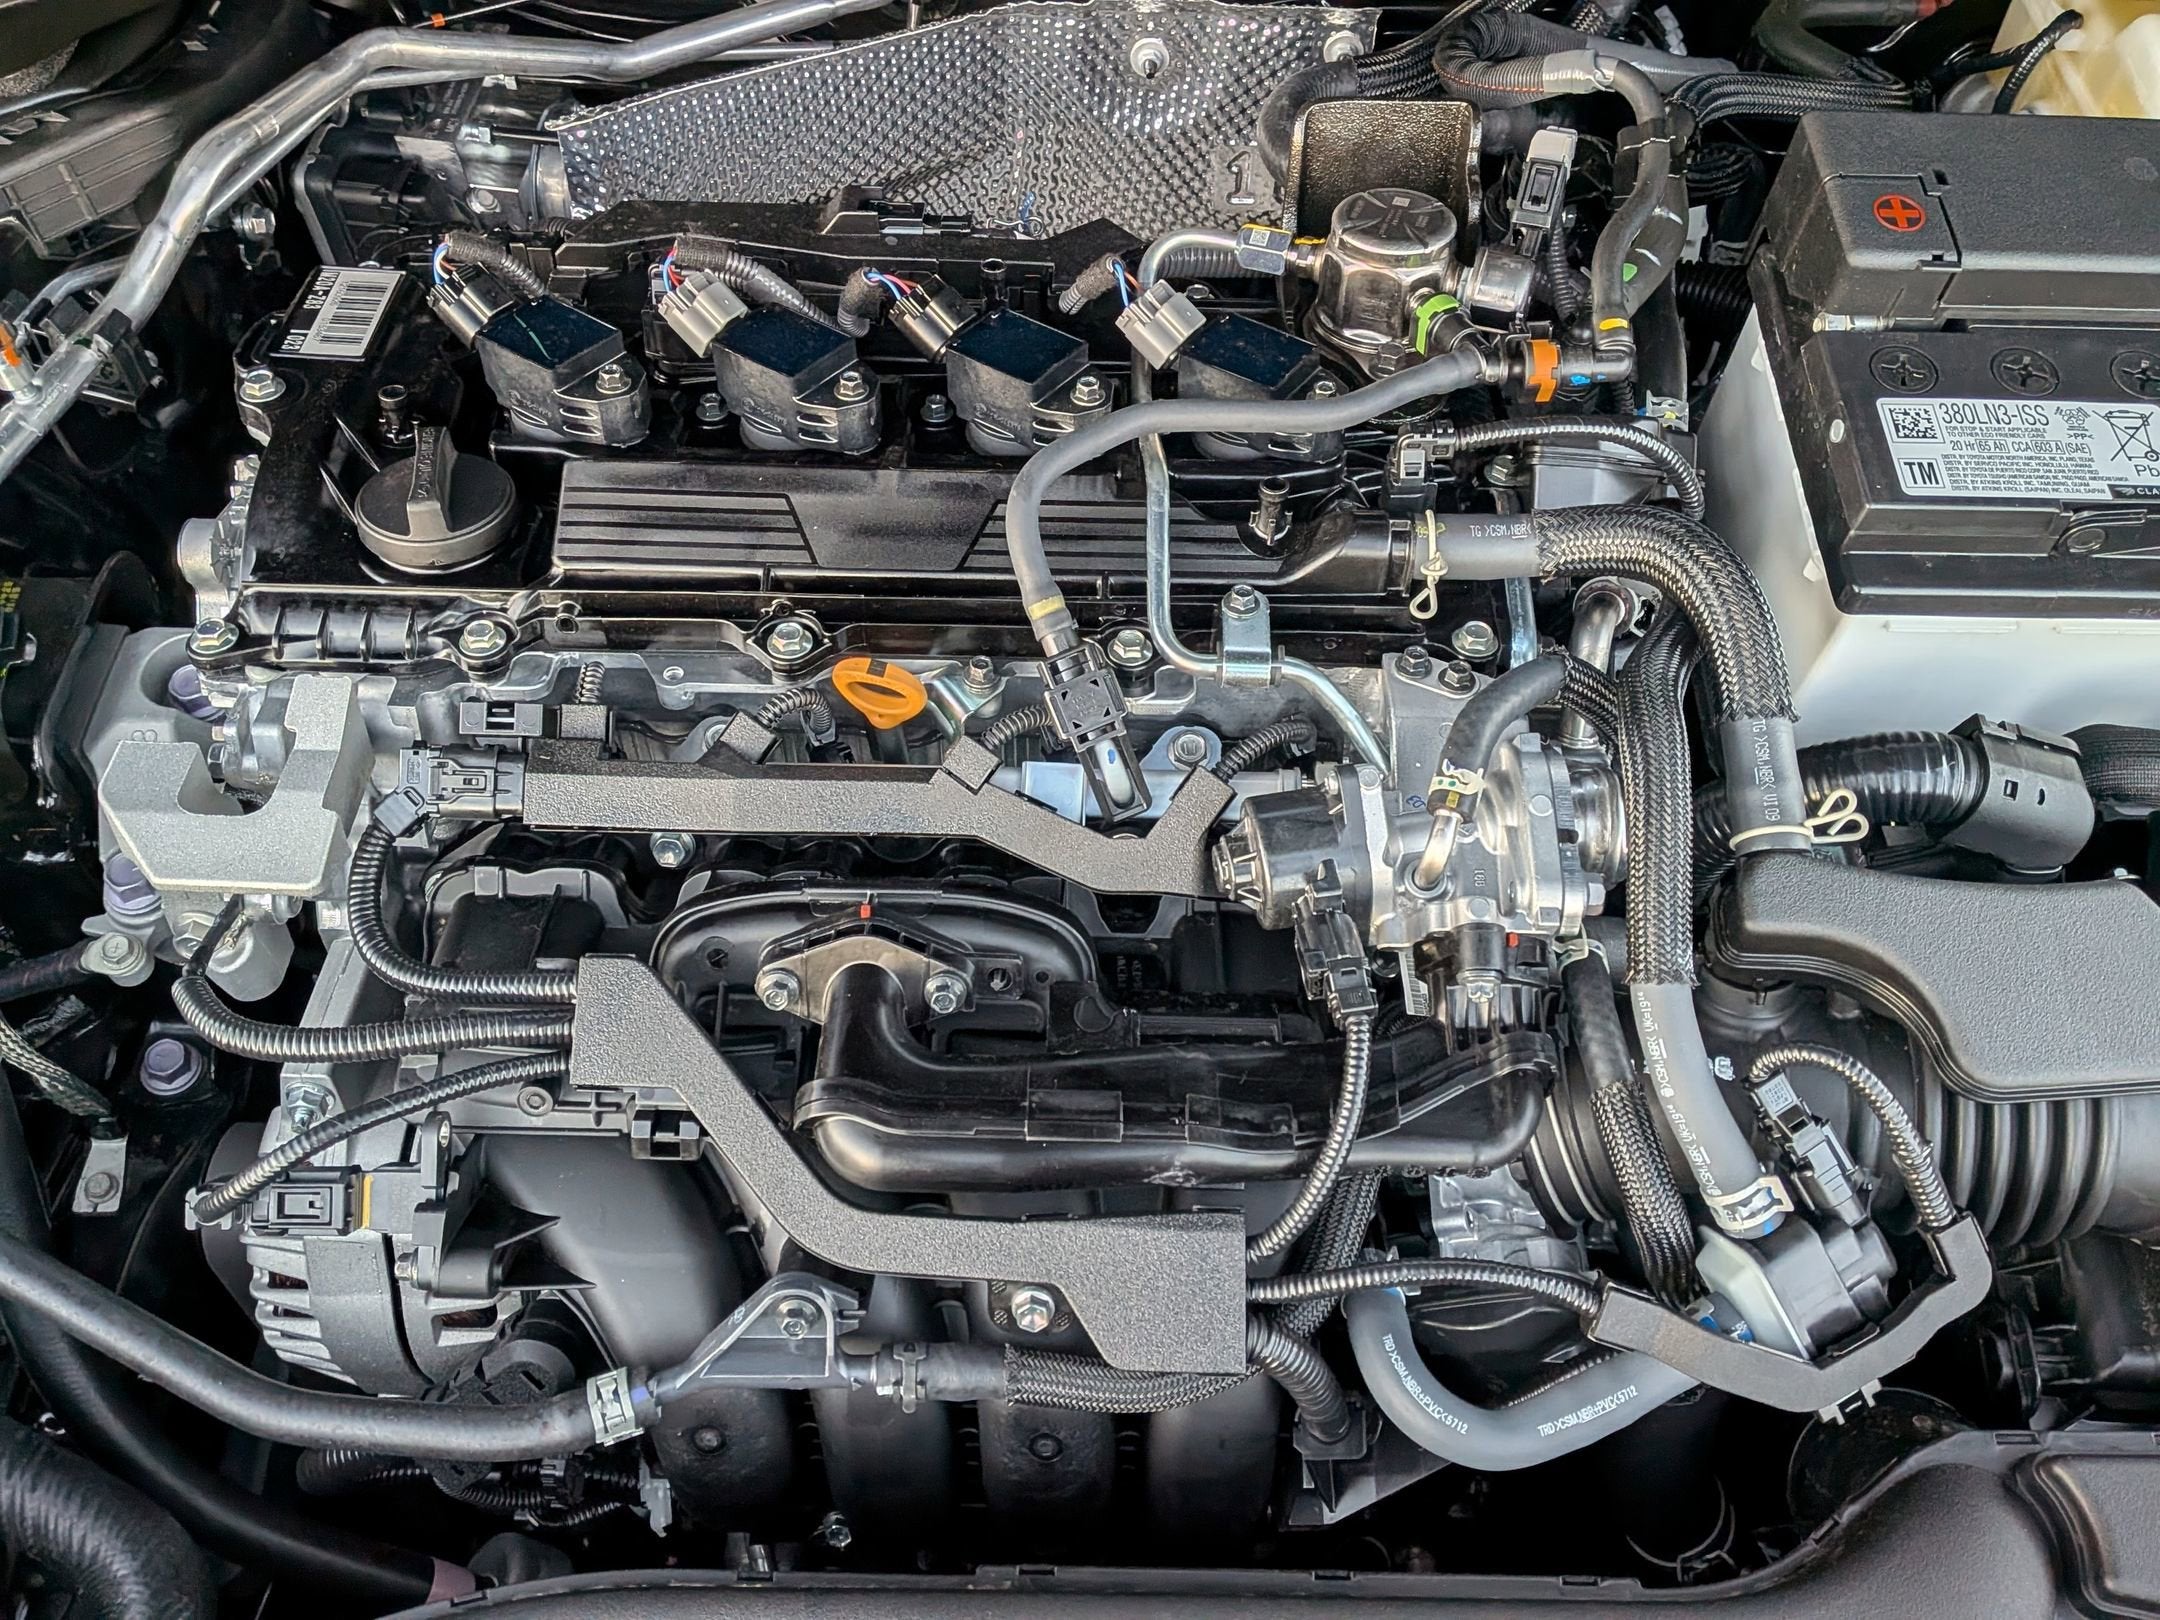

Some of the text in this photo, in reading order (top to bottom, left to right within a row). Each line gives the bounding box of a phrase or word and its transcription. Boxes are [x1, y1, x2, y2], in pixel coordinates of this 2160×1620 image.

[1227, 150, 1256, 205] 1
[1939, 403, 2049, 426] 380LN3-ISS
[1950, 440, 2091, 456] 20 Hr 65 Ah CCA 603 A (SAE)
[1904, 462, 1940, 485] TM
[2134, 464, 2160, 478] Pb
[2136, 487, 2160, 496] CLA
[1470, 525, 1482, 538] TG
[1753, 719, 1767, 732] TG
